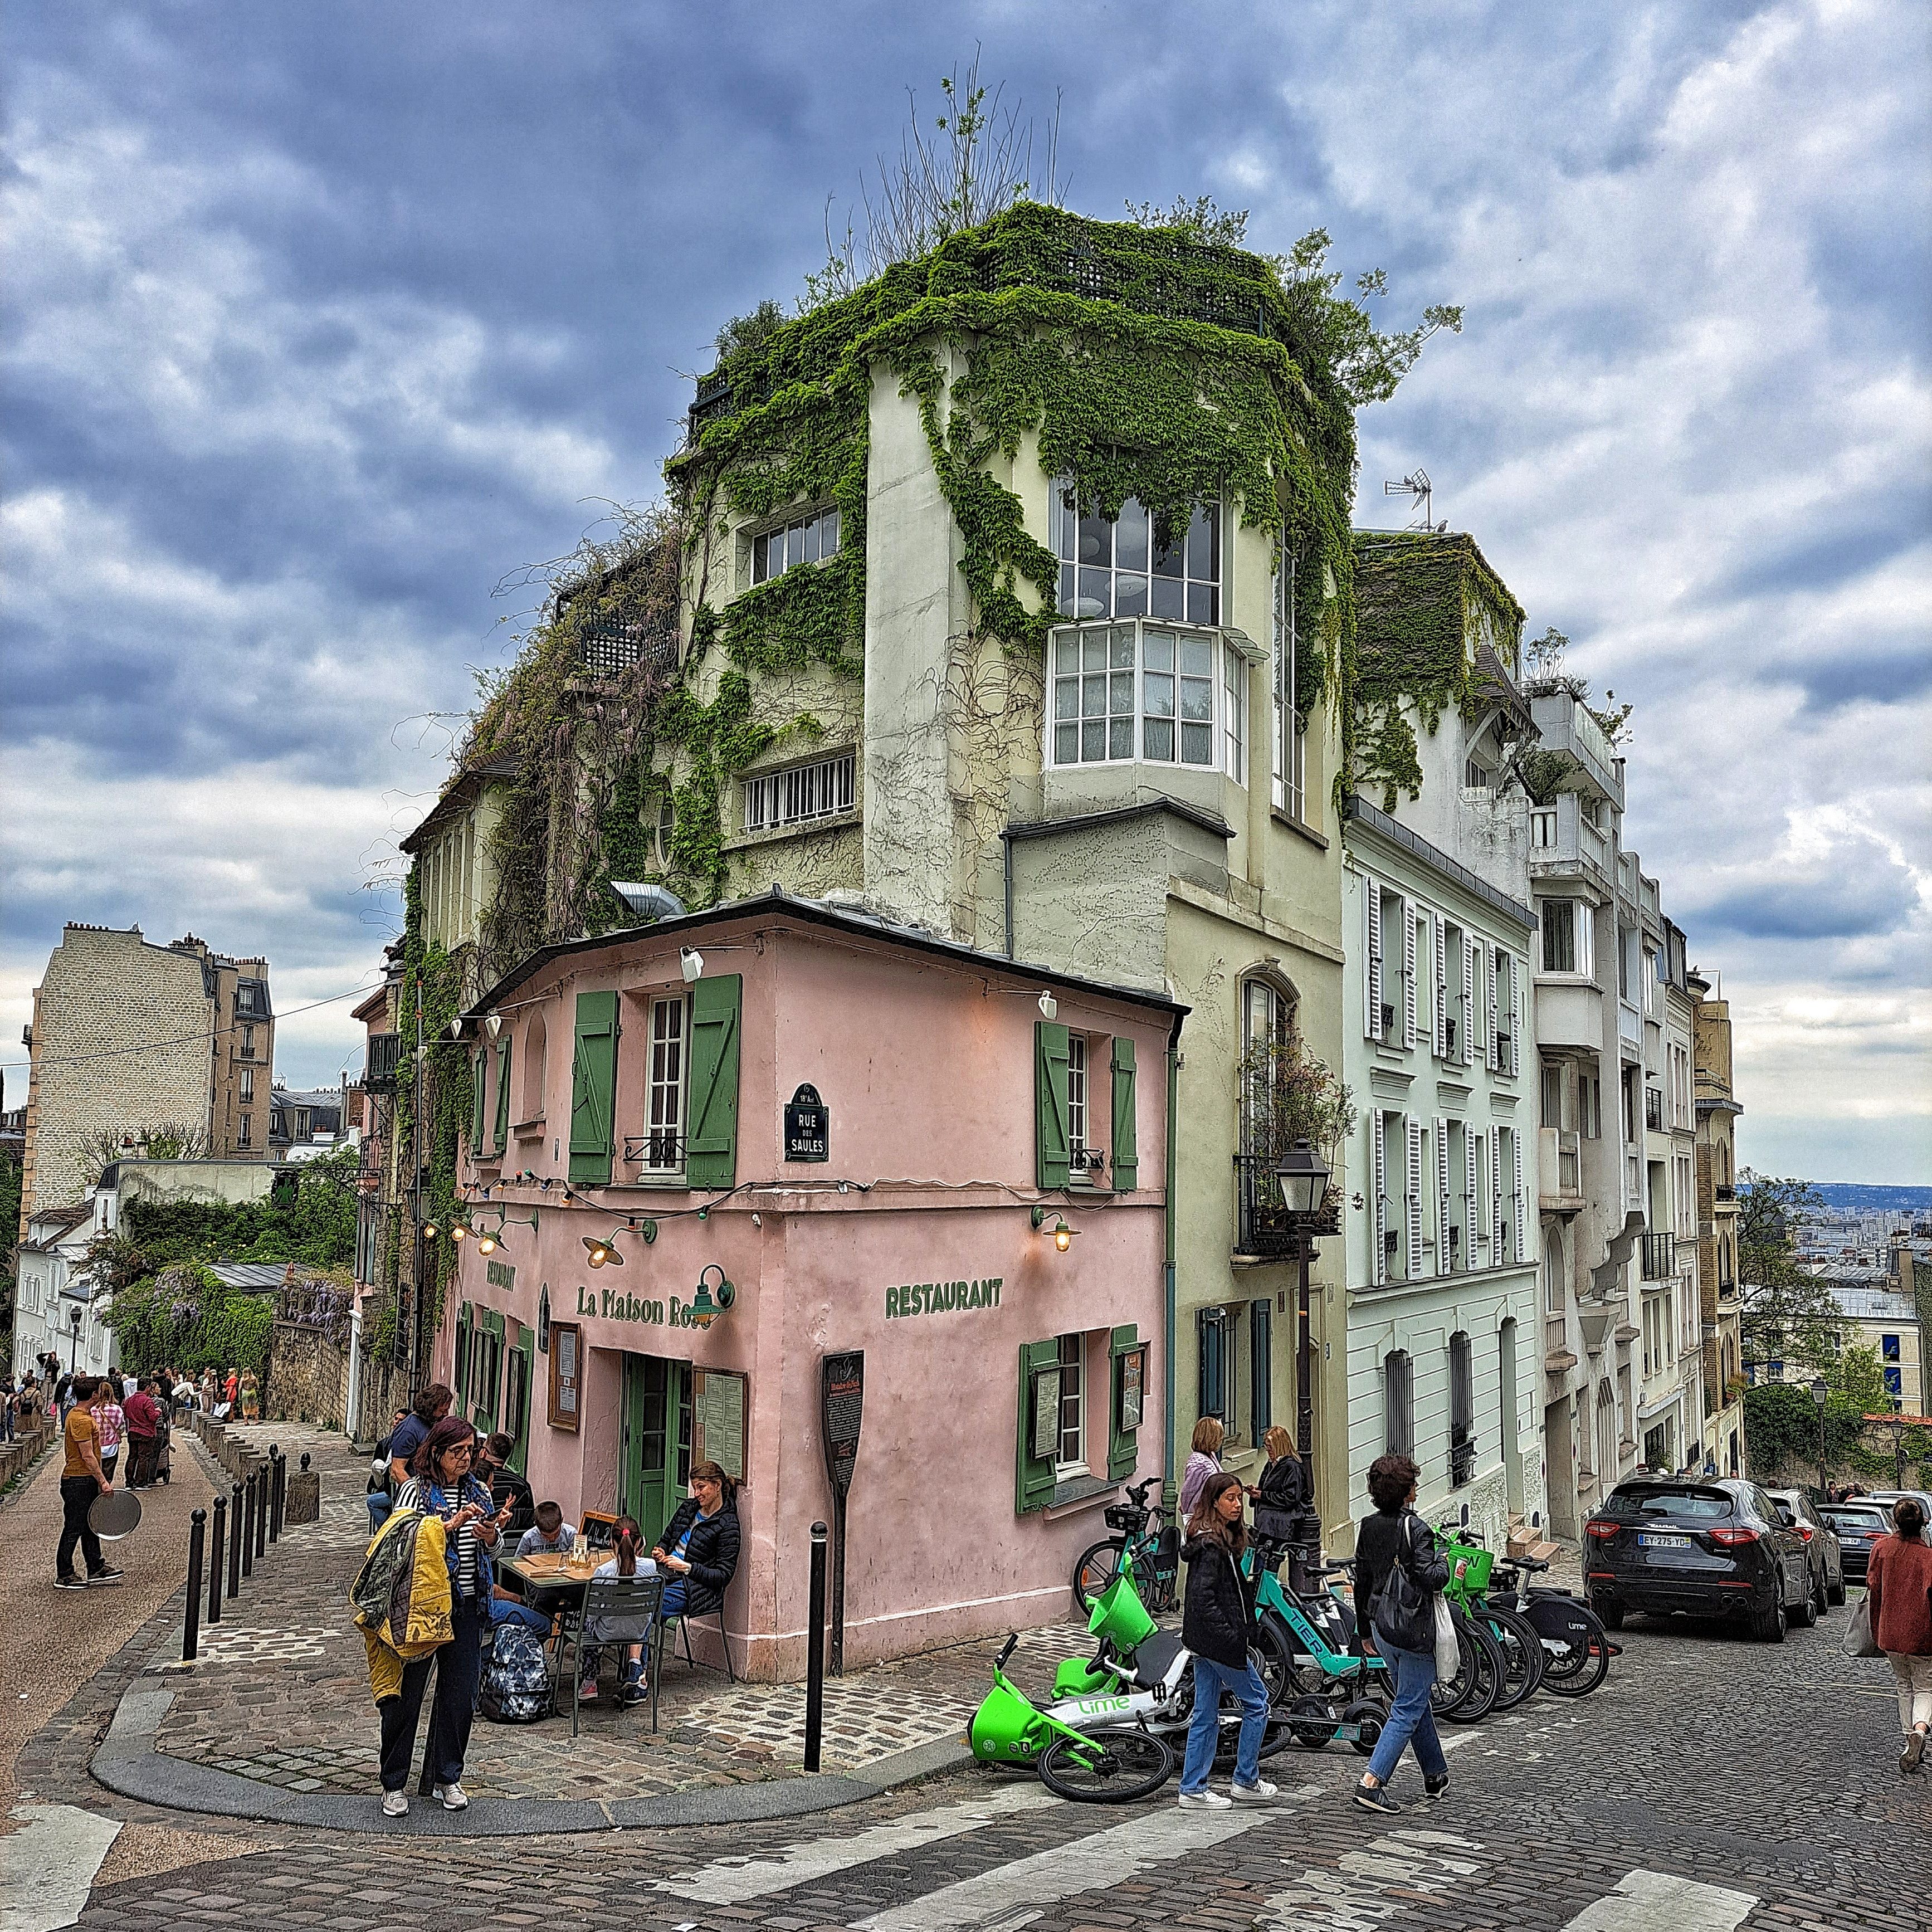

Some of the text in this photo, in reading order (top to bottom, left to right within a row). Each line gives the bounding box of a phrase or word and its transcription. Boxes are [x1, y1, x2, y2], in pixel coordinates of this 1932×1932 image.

[798, 1114, 817, 1128] RUE
[791, 1139, 823, 1153] SAULES
[576, 1286, 597, 1318] La
[601, 1288, 665, 1325] Maison
[886, 1278, 1003, 1319] RESTAURANT
[1644, 1536, 1685, 1547] EY-275-YD
[1290, 1609, 1323, 1657] TIER
